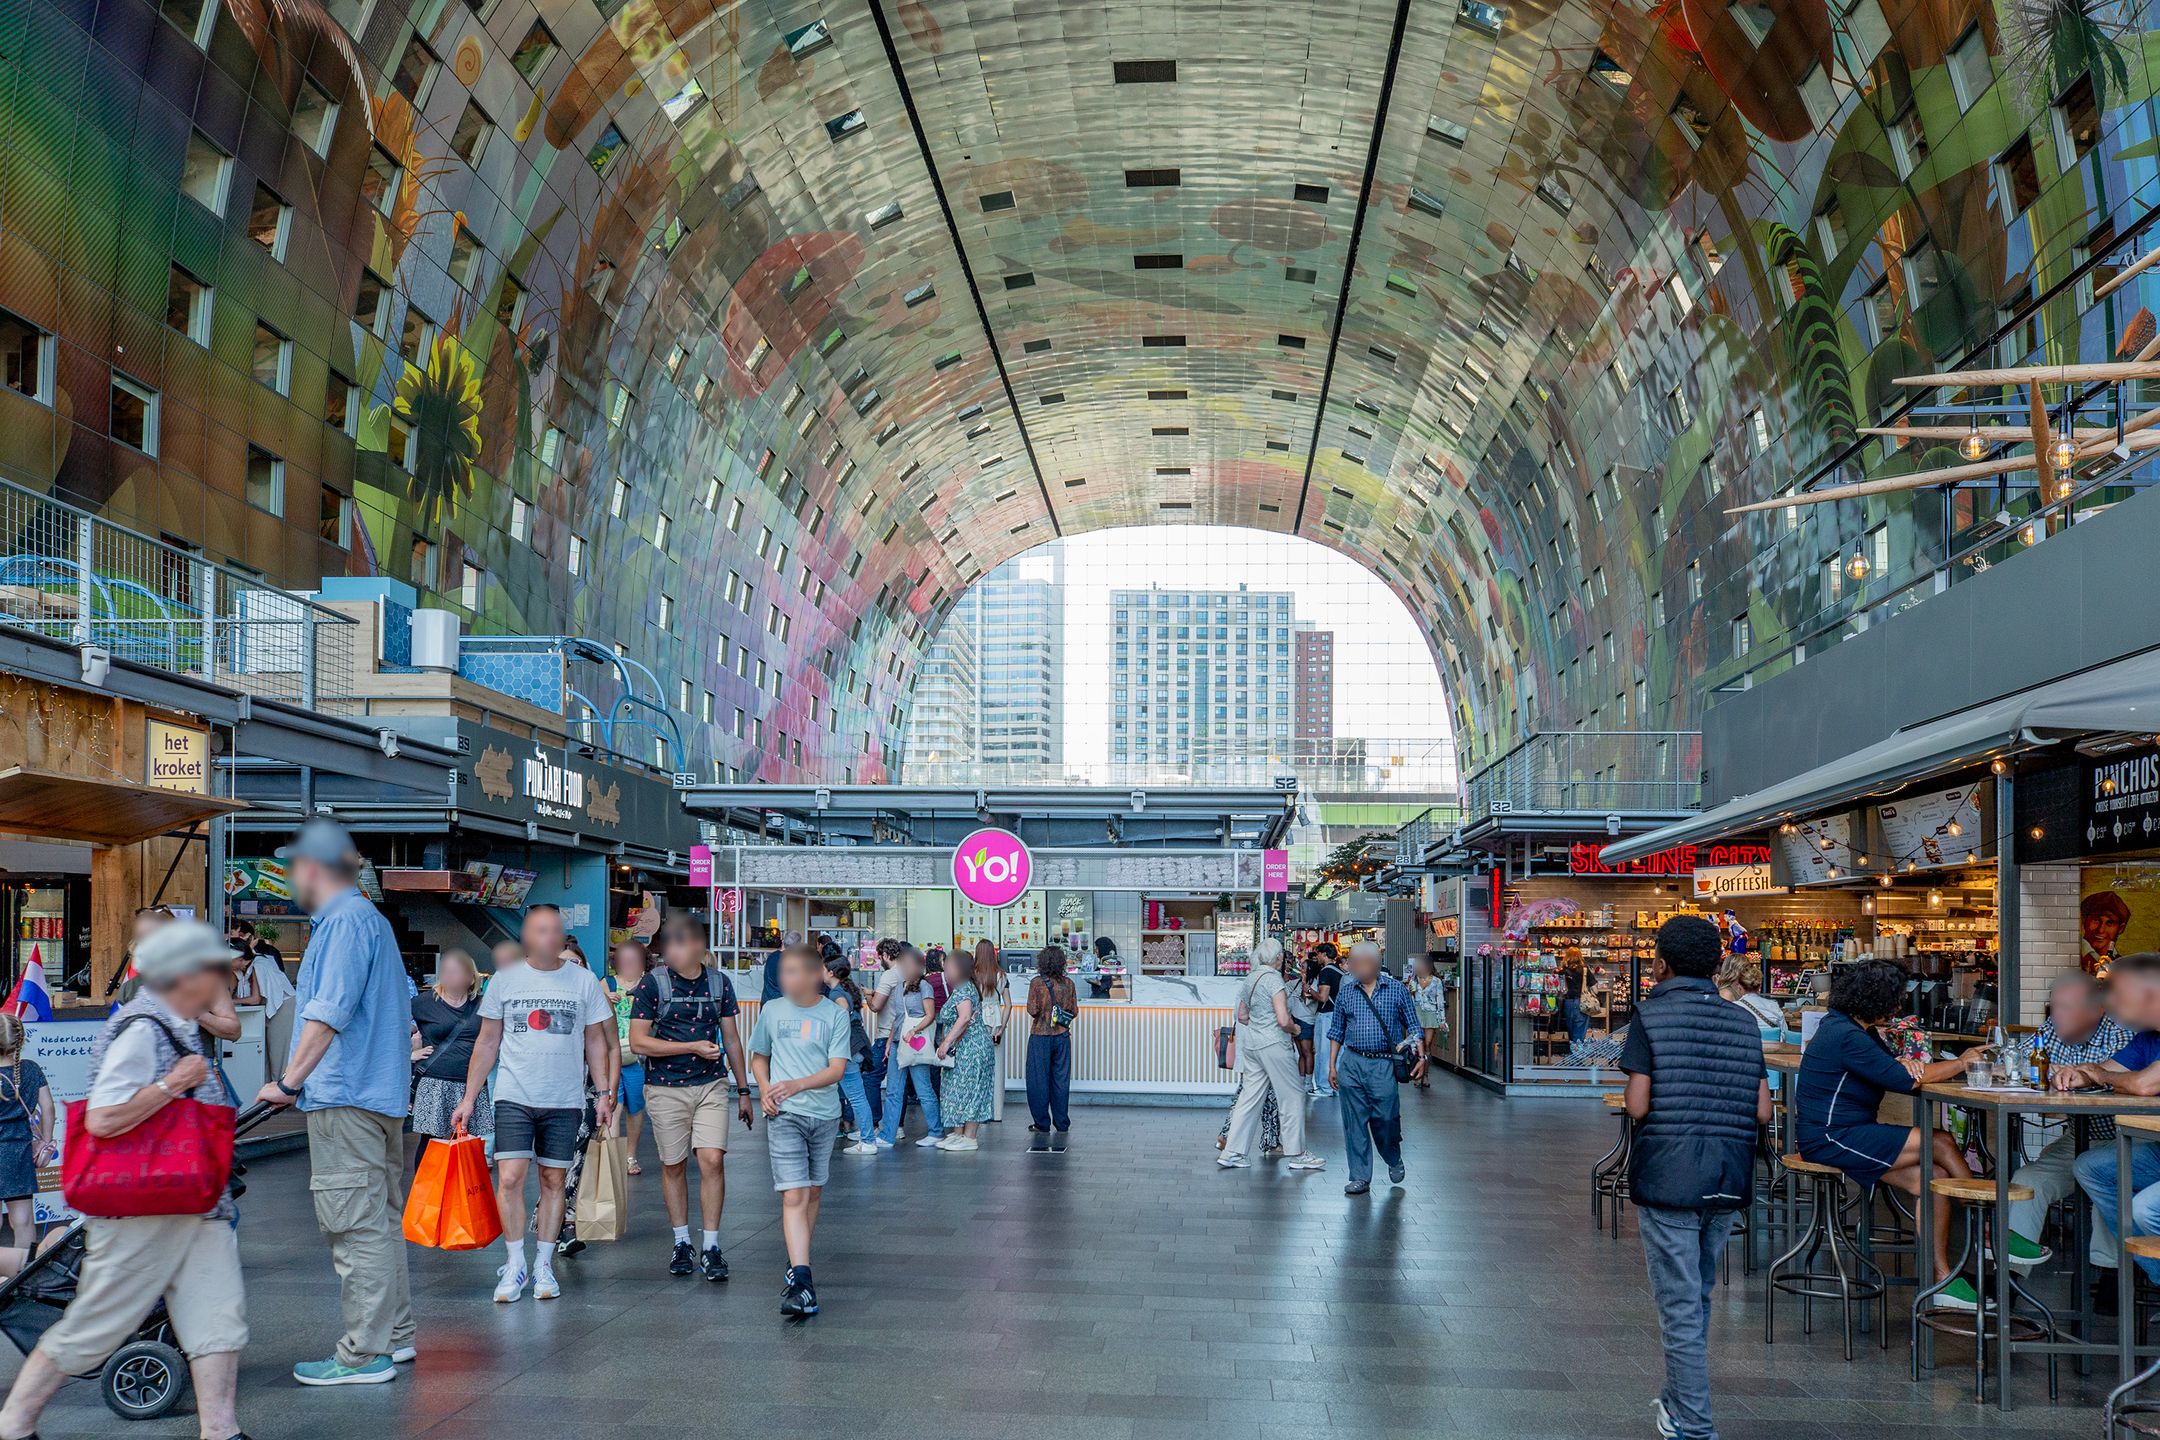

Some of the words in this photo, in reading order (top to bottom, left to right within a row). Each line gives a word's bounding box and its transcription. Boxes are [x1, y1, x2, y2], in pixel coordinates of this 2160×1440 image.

[165, 732, 189, 750] het
[153, 757, 202, 776] kroket
[525, 752, 562, 803] PUNJABI
[563, 768, 583, 809] FOOD
[1275, 777, 1297, 790] 52
[2094, 753, 2160, 799] PINCHOS
[1491, 801, 1512, 813] 32
[962, 848, 1020, 884] YO!
[1396, 855, 1411, 864] 28
[1571, 844, 1698, 874] SKINE
[1715, 875, 1783, 893] COFFEESH
[511, 999, 521, 1007] JP
[521, 998, 578, 1008] PERFORMANCE
[38, 1046, 94, 1057] Krokett
